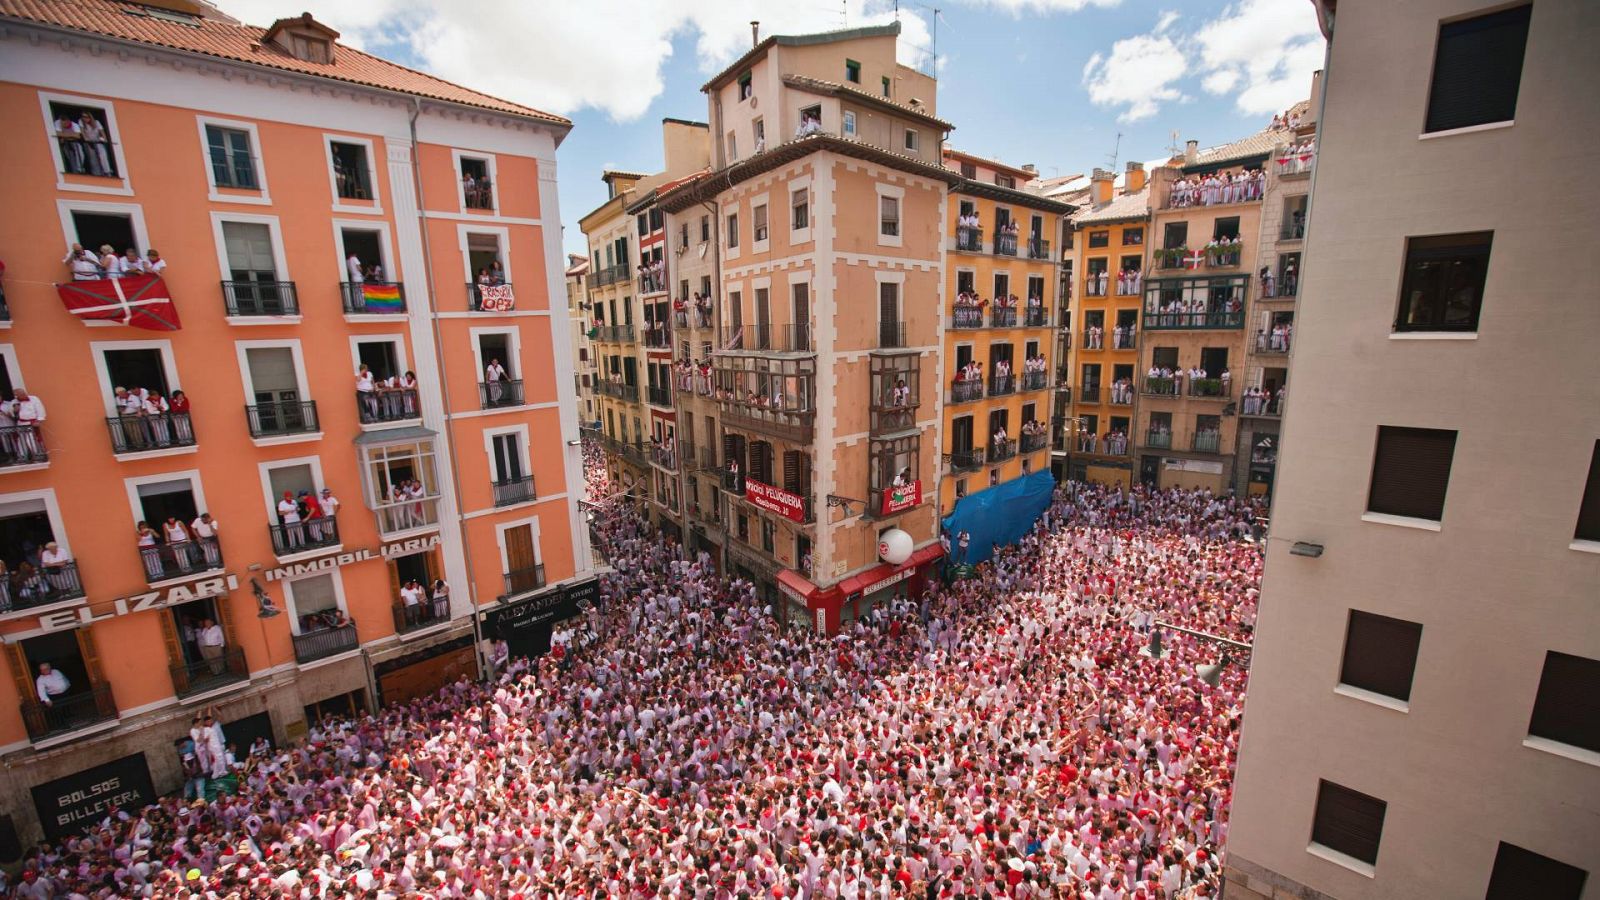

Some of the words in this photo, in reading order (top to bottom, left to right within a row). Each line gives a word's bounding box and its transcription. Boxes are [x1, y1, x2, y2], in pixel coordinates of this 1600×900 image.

[766, 486, 803, 511] PELUQUERIA
[265, 534, 440, 582] INMOBILIARIA
[40, 574, 239, 633] ELIZARI
[497, 593, 566, 623] ALEXANDER
[570, 587, 594, 600] JOYERO
[57, 789, 140, 826] BILLETERA
[58, 776, 120, 807] BOLSOS
